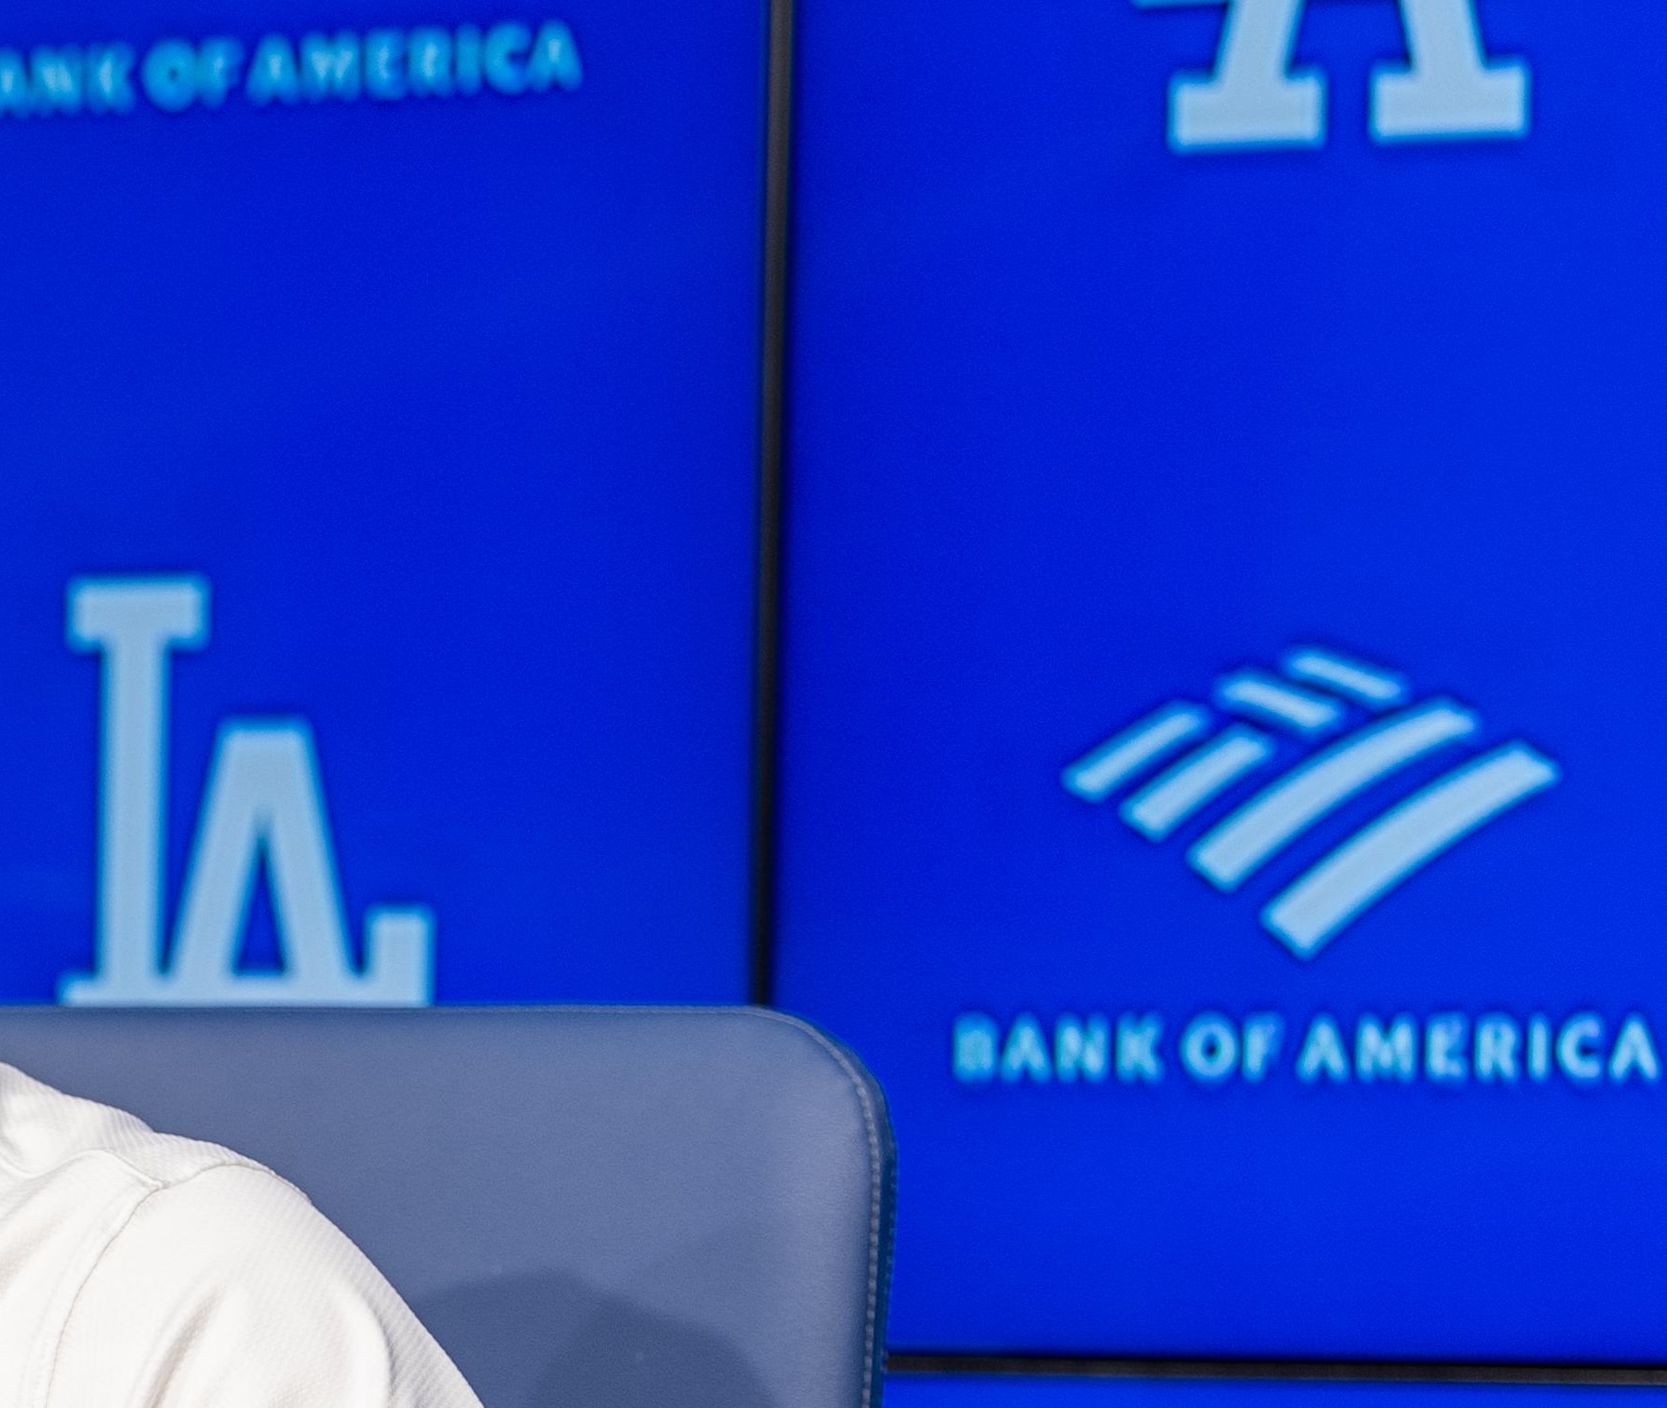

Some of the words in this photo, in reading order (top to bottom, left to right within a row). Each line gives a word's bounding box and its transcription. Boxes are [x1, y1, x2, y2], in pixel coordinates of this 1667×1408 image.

[142, 35, 244, 112] OF
[245, 18, 583, 106] AMERICA
[57, 573, 435, 1007] LA
[951, 1010, 1164, 1083] BANK
[1178, 1010, 1285, 1083] OF
[1294, 1010, 1661, 1083] AMERICA
